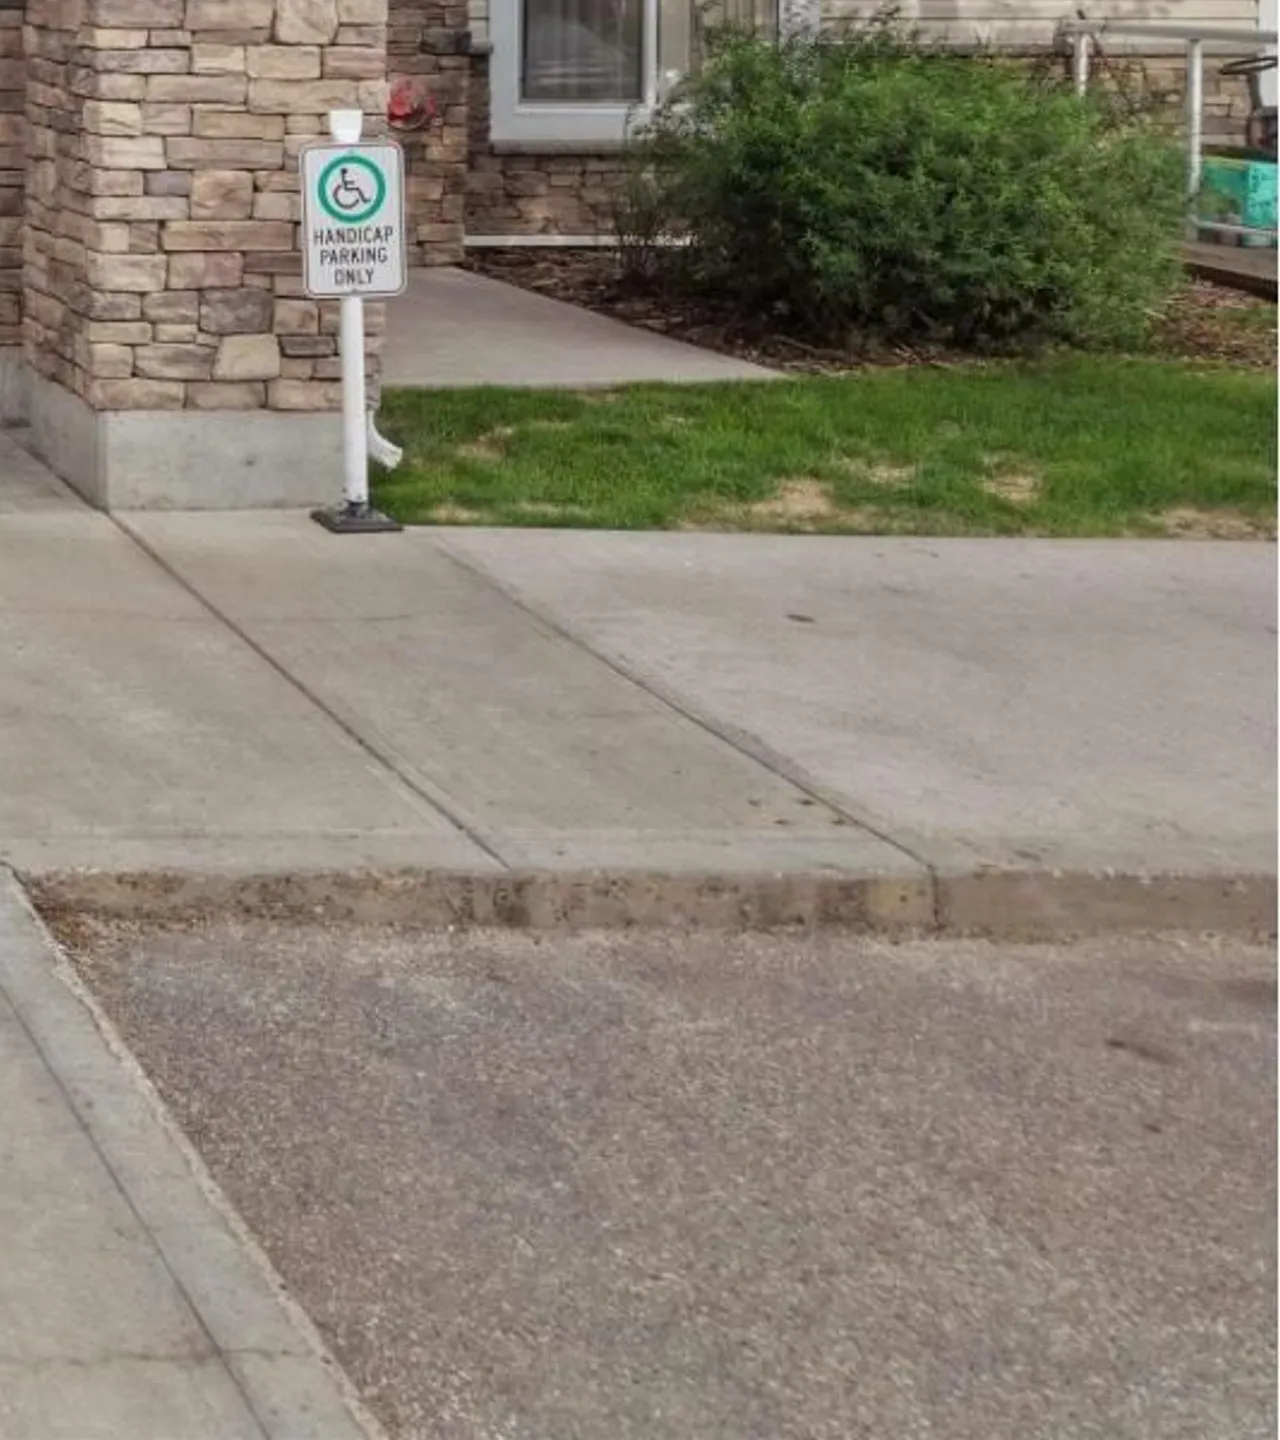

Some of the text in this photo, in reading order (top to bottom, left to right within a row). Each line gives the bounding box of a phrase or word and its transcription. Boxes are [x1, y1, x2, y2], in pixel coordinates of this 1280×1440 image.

[313, 226, 394, 245] HANDICAP
[320, 247, 388, 265] PARKING
[334, 269, 374, 285] ONLY
